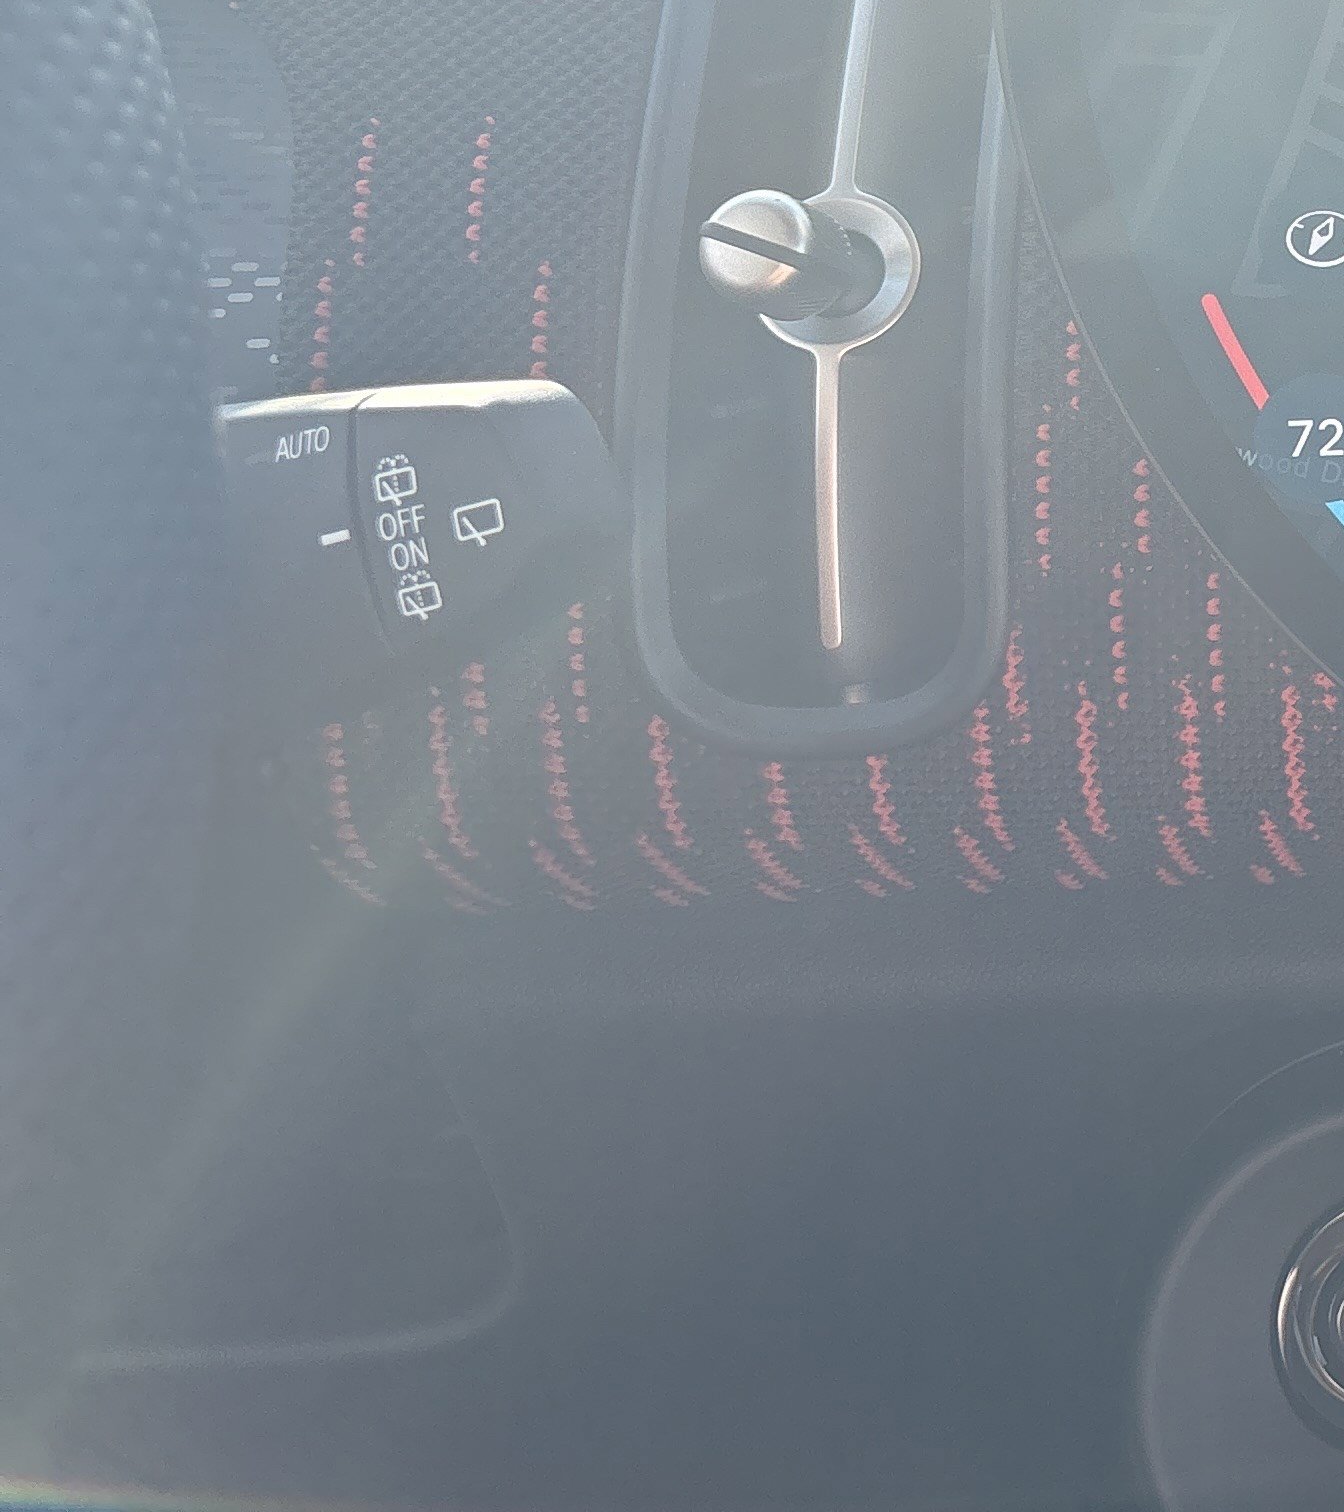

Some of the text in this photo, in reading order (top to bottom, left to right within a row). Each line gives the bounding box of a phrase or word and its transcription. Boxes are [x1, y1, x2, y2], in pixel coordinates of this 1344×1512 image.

[274, 426, 330, 463] AUTO
[378, 505, 426, 541] OFF
[390, 537, 430, 571] ON
